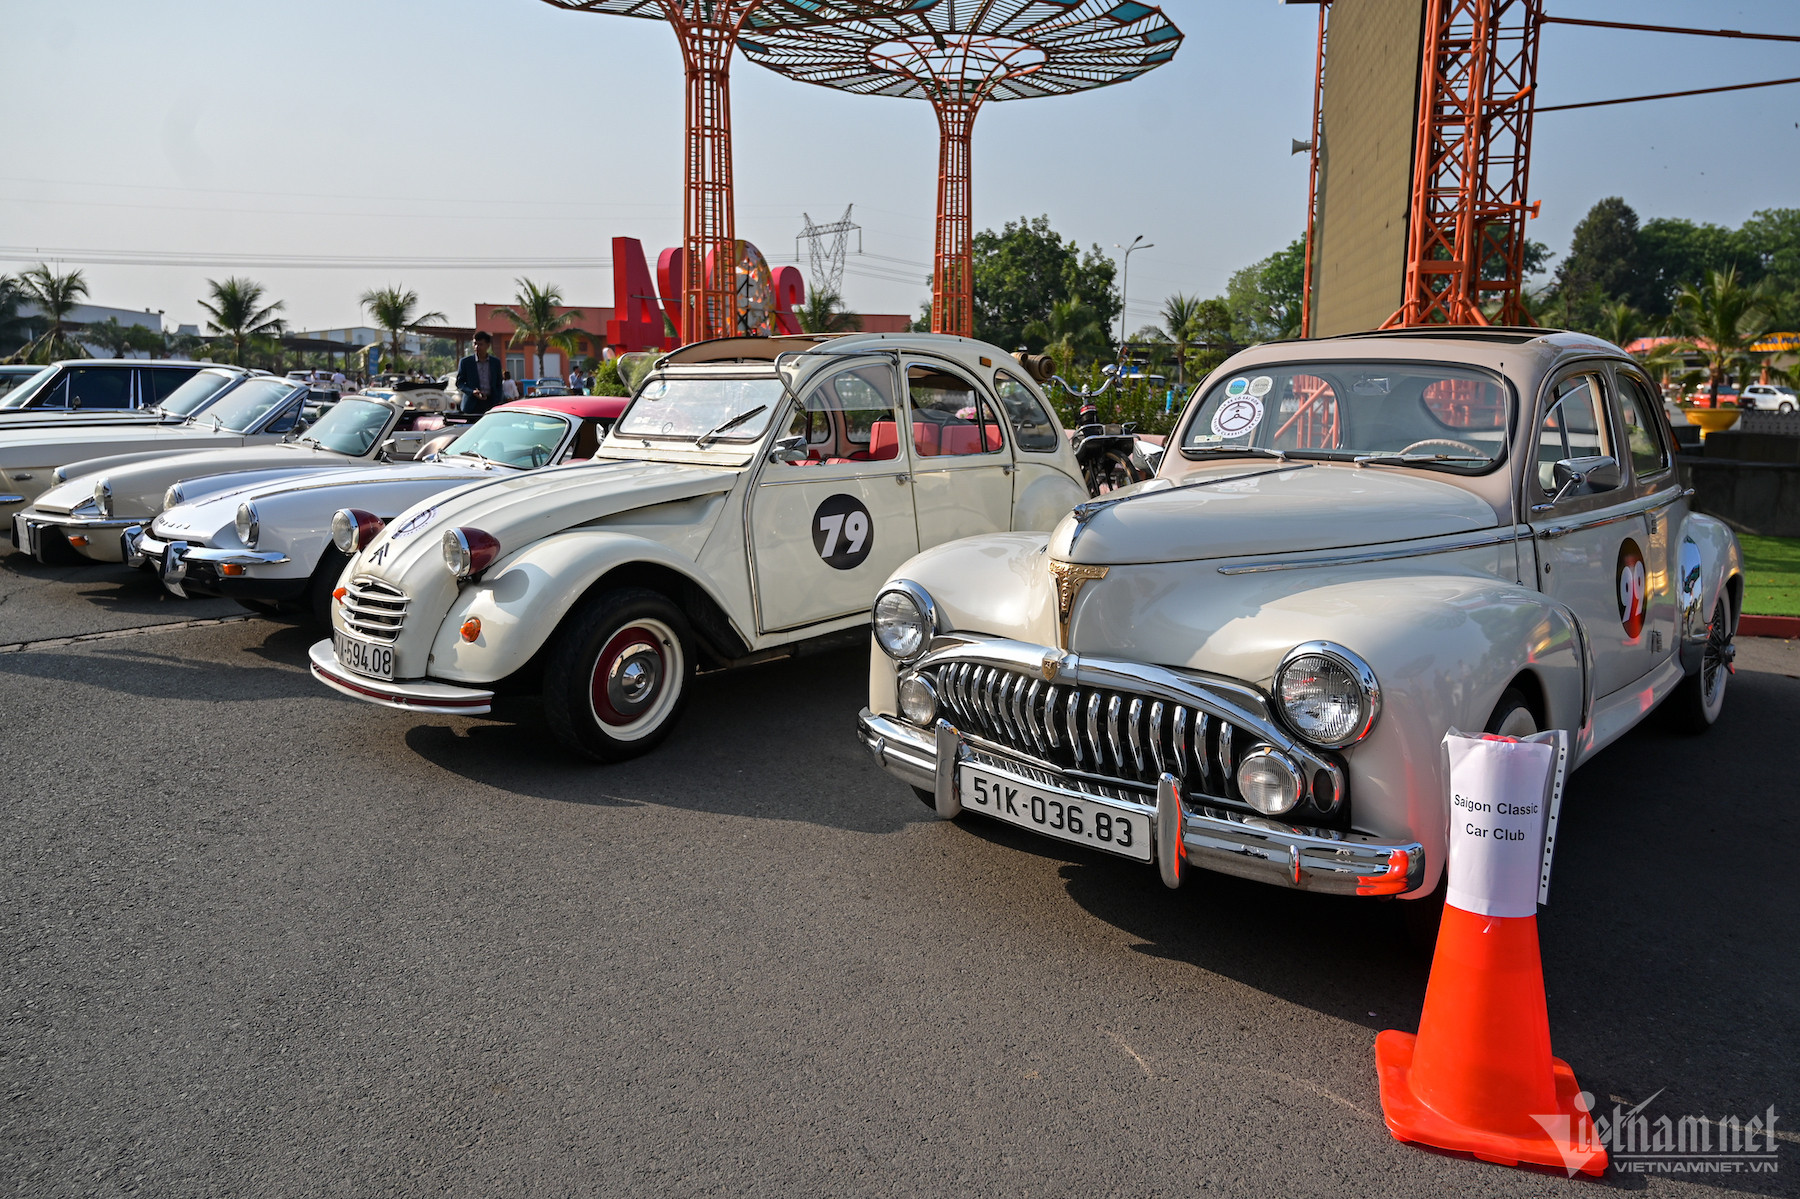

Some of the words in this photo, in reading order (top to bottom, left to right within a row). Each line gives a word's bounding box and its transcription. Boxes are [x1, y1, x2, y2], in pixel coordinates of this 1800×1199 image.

[820, 510, 869, 558] 79
[1620, 560, 1645, 623] 99
[974, 776, 1133, 848] 51K-036.83
[1454, 794, 1491, 812] Saigon
[1496, 802, 1539, 815] Classic
[1465, 823, 1488, 838] Car
[1493, 828, 1525, 841] Club
